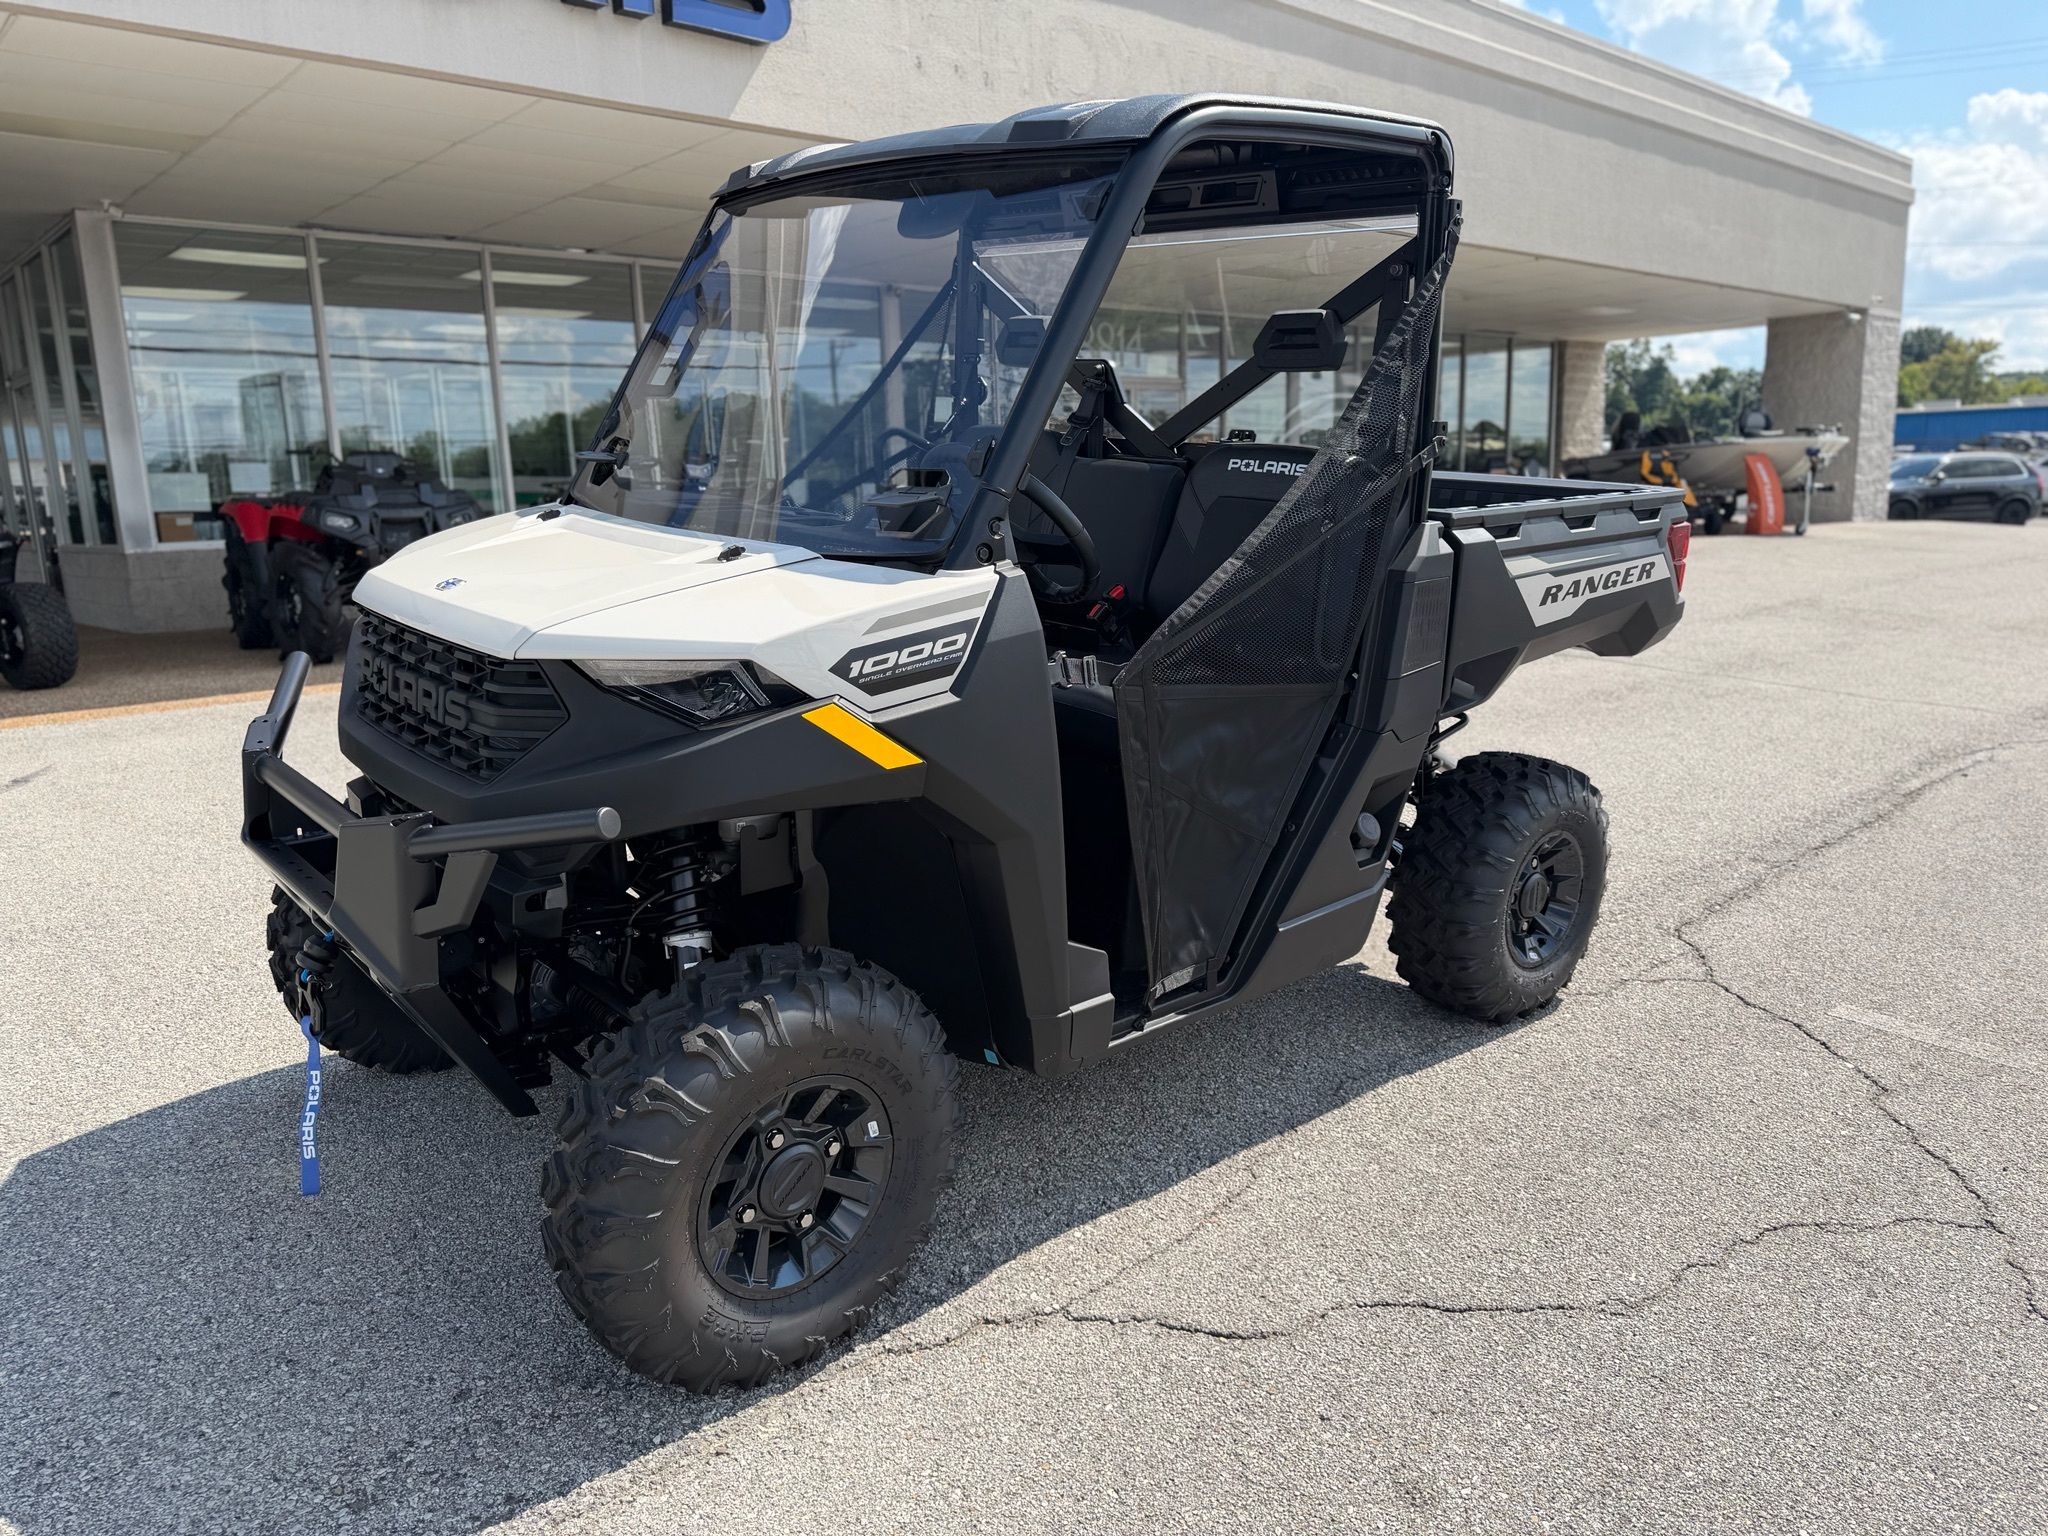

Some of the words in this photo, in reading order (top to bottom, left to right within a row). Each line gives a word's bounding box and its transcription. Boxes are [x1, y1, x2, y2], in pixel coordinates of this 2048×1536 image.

[1227, 458, 1308, 476] POLARIS
[1538, 561, 1656, 608] RANGER
[848, 632, 967, 679] 1000
[858, 670, 892, 684] SINGLE
[895, 656, 943, 674] OVERHEAD
[943, 651, 963, 661] CAM
[356, 648, 470, 731] POLARIS
[824, 1046, 913, 1096] CARLSTAR
[301, 1070, 320, 1160] POLARIS
